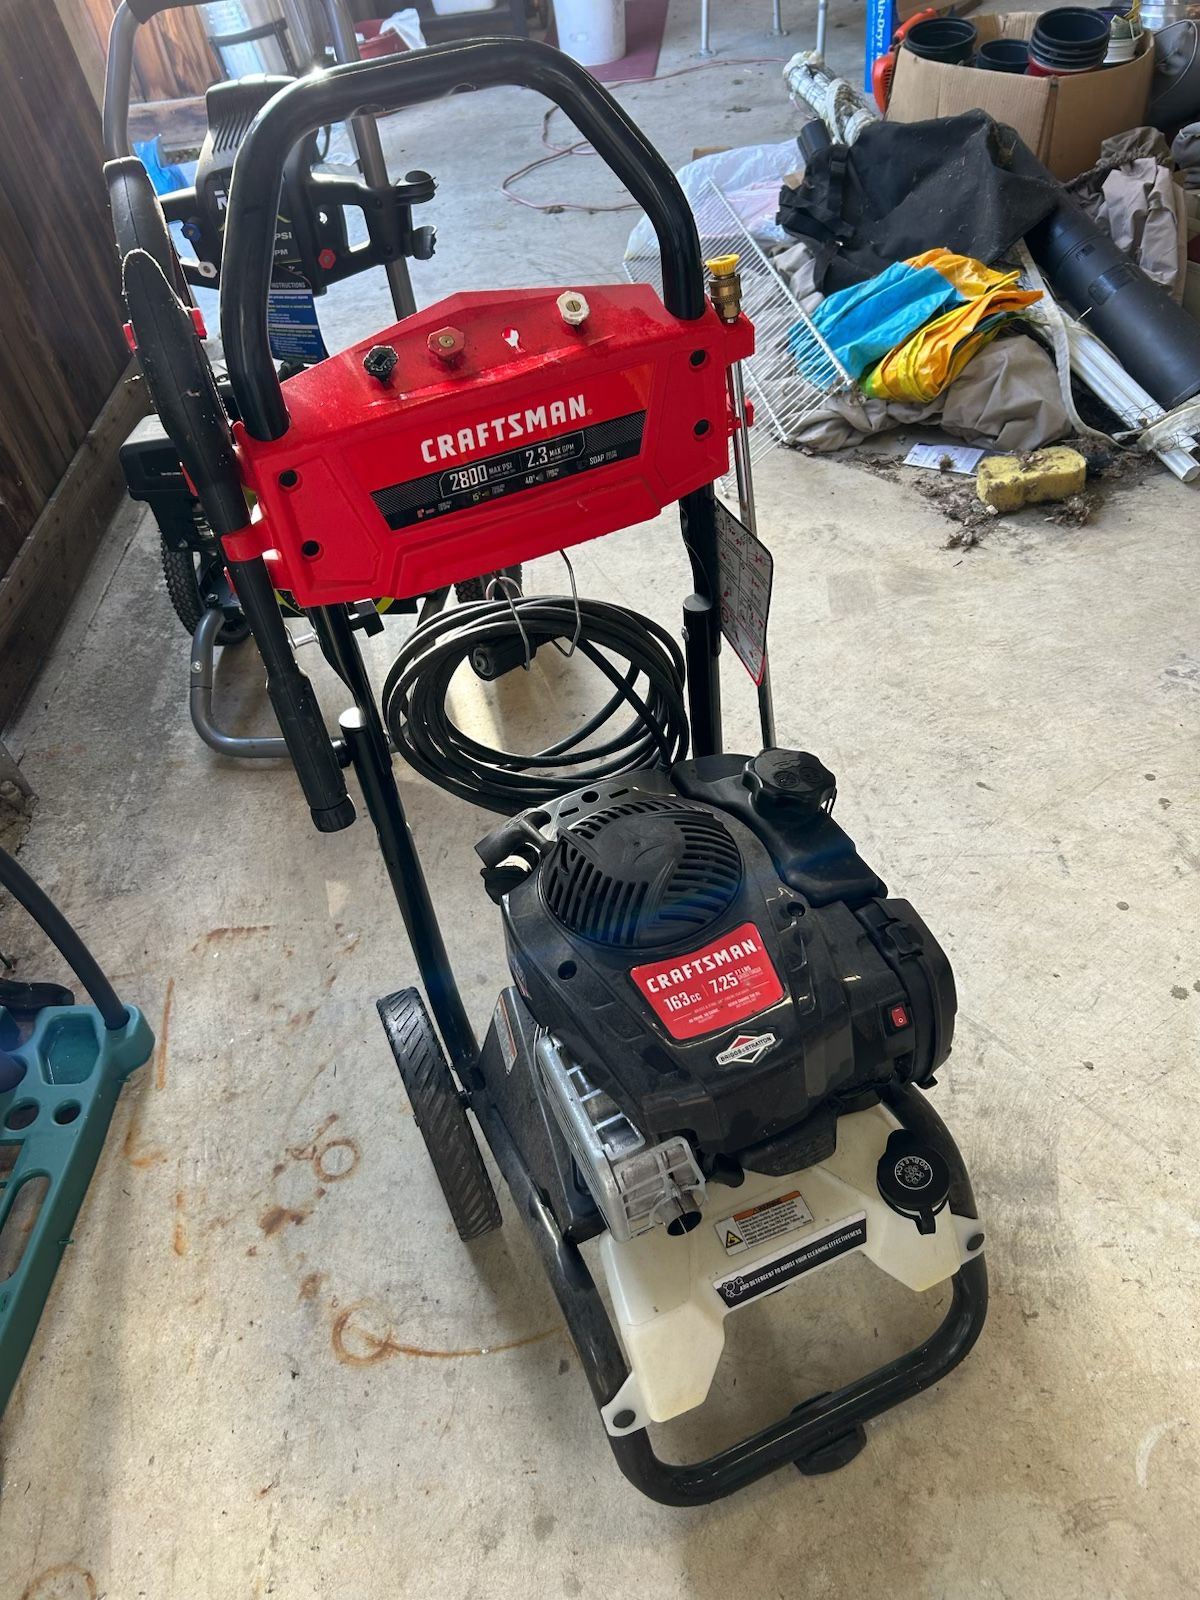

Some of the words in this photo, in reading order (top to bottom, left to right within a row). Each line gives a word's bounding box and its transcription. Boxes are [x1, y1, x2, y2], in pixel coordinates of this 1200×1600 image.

[420, 394, 586, 464] CRAFTSMAN
[525, 446, 549, 469] 2.3
[549, 447, 562, 458] MAX
[561, 443, 575, 454] GPM
[589, 454, 605, 466] SOAP
[449, 464, 489, 492] 2800
[488, 464, 502, 475] MAX
[501, 461, 514, 471] PSI
[646, 939, 758, 993] CRAFTSMAN
[708, 972, 740, 994] 7.25
[720, 1047, 742, 1062] BRIGGS
[745, 1036, 773, 1051] STRATTON
